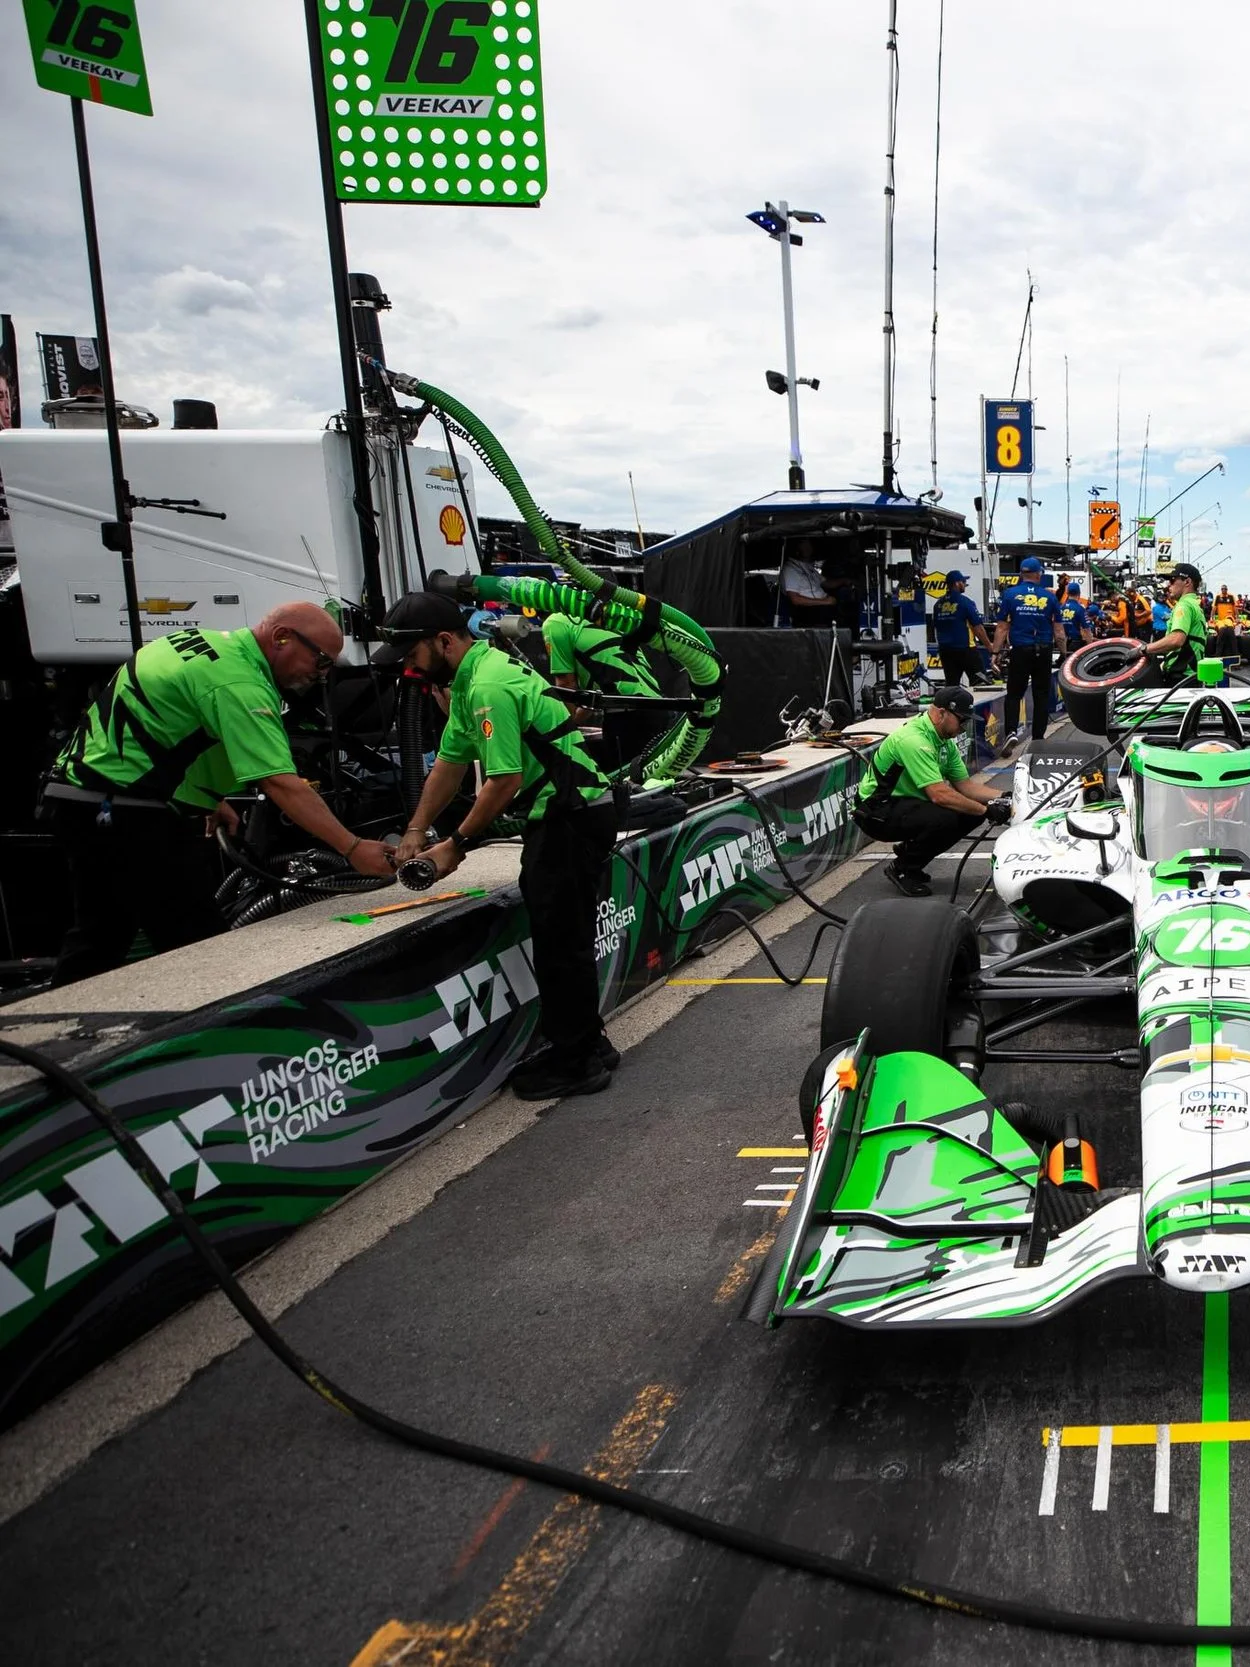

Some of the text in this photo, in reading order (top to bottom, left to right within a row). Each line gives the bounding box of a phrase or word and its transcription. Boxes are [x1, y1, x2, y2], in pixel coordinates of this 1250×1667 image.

[368, 0, 492, 84] 76
[58, 54, 124, 81] VEEKAY
[385, 97, 484, 114] VEEKAY
[997, 425, 1021, 468] 8
[425, 483, 470, 494] CHEVROLT
[1035, 758, 1083, 766] AIPEX
[1003, 852, 1053, 864] DCM
[1011, 867, 1090, 881] Firestone
[240, 1038, 338, 1110] JUNCOS
[242, 1044, 380, 1138] HOLLINGER
[1208, 1091, 1241, 1100] NTT
[1180, 1104, 1248, 1115] INDYCAR
[248, 1089, 347, 1164] RACING
